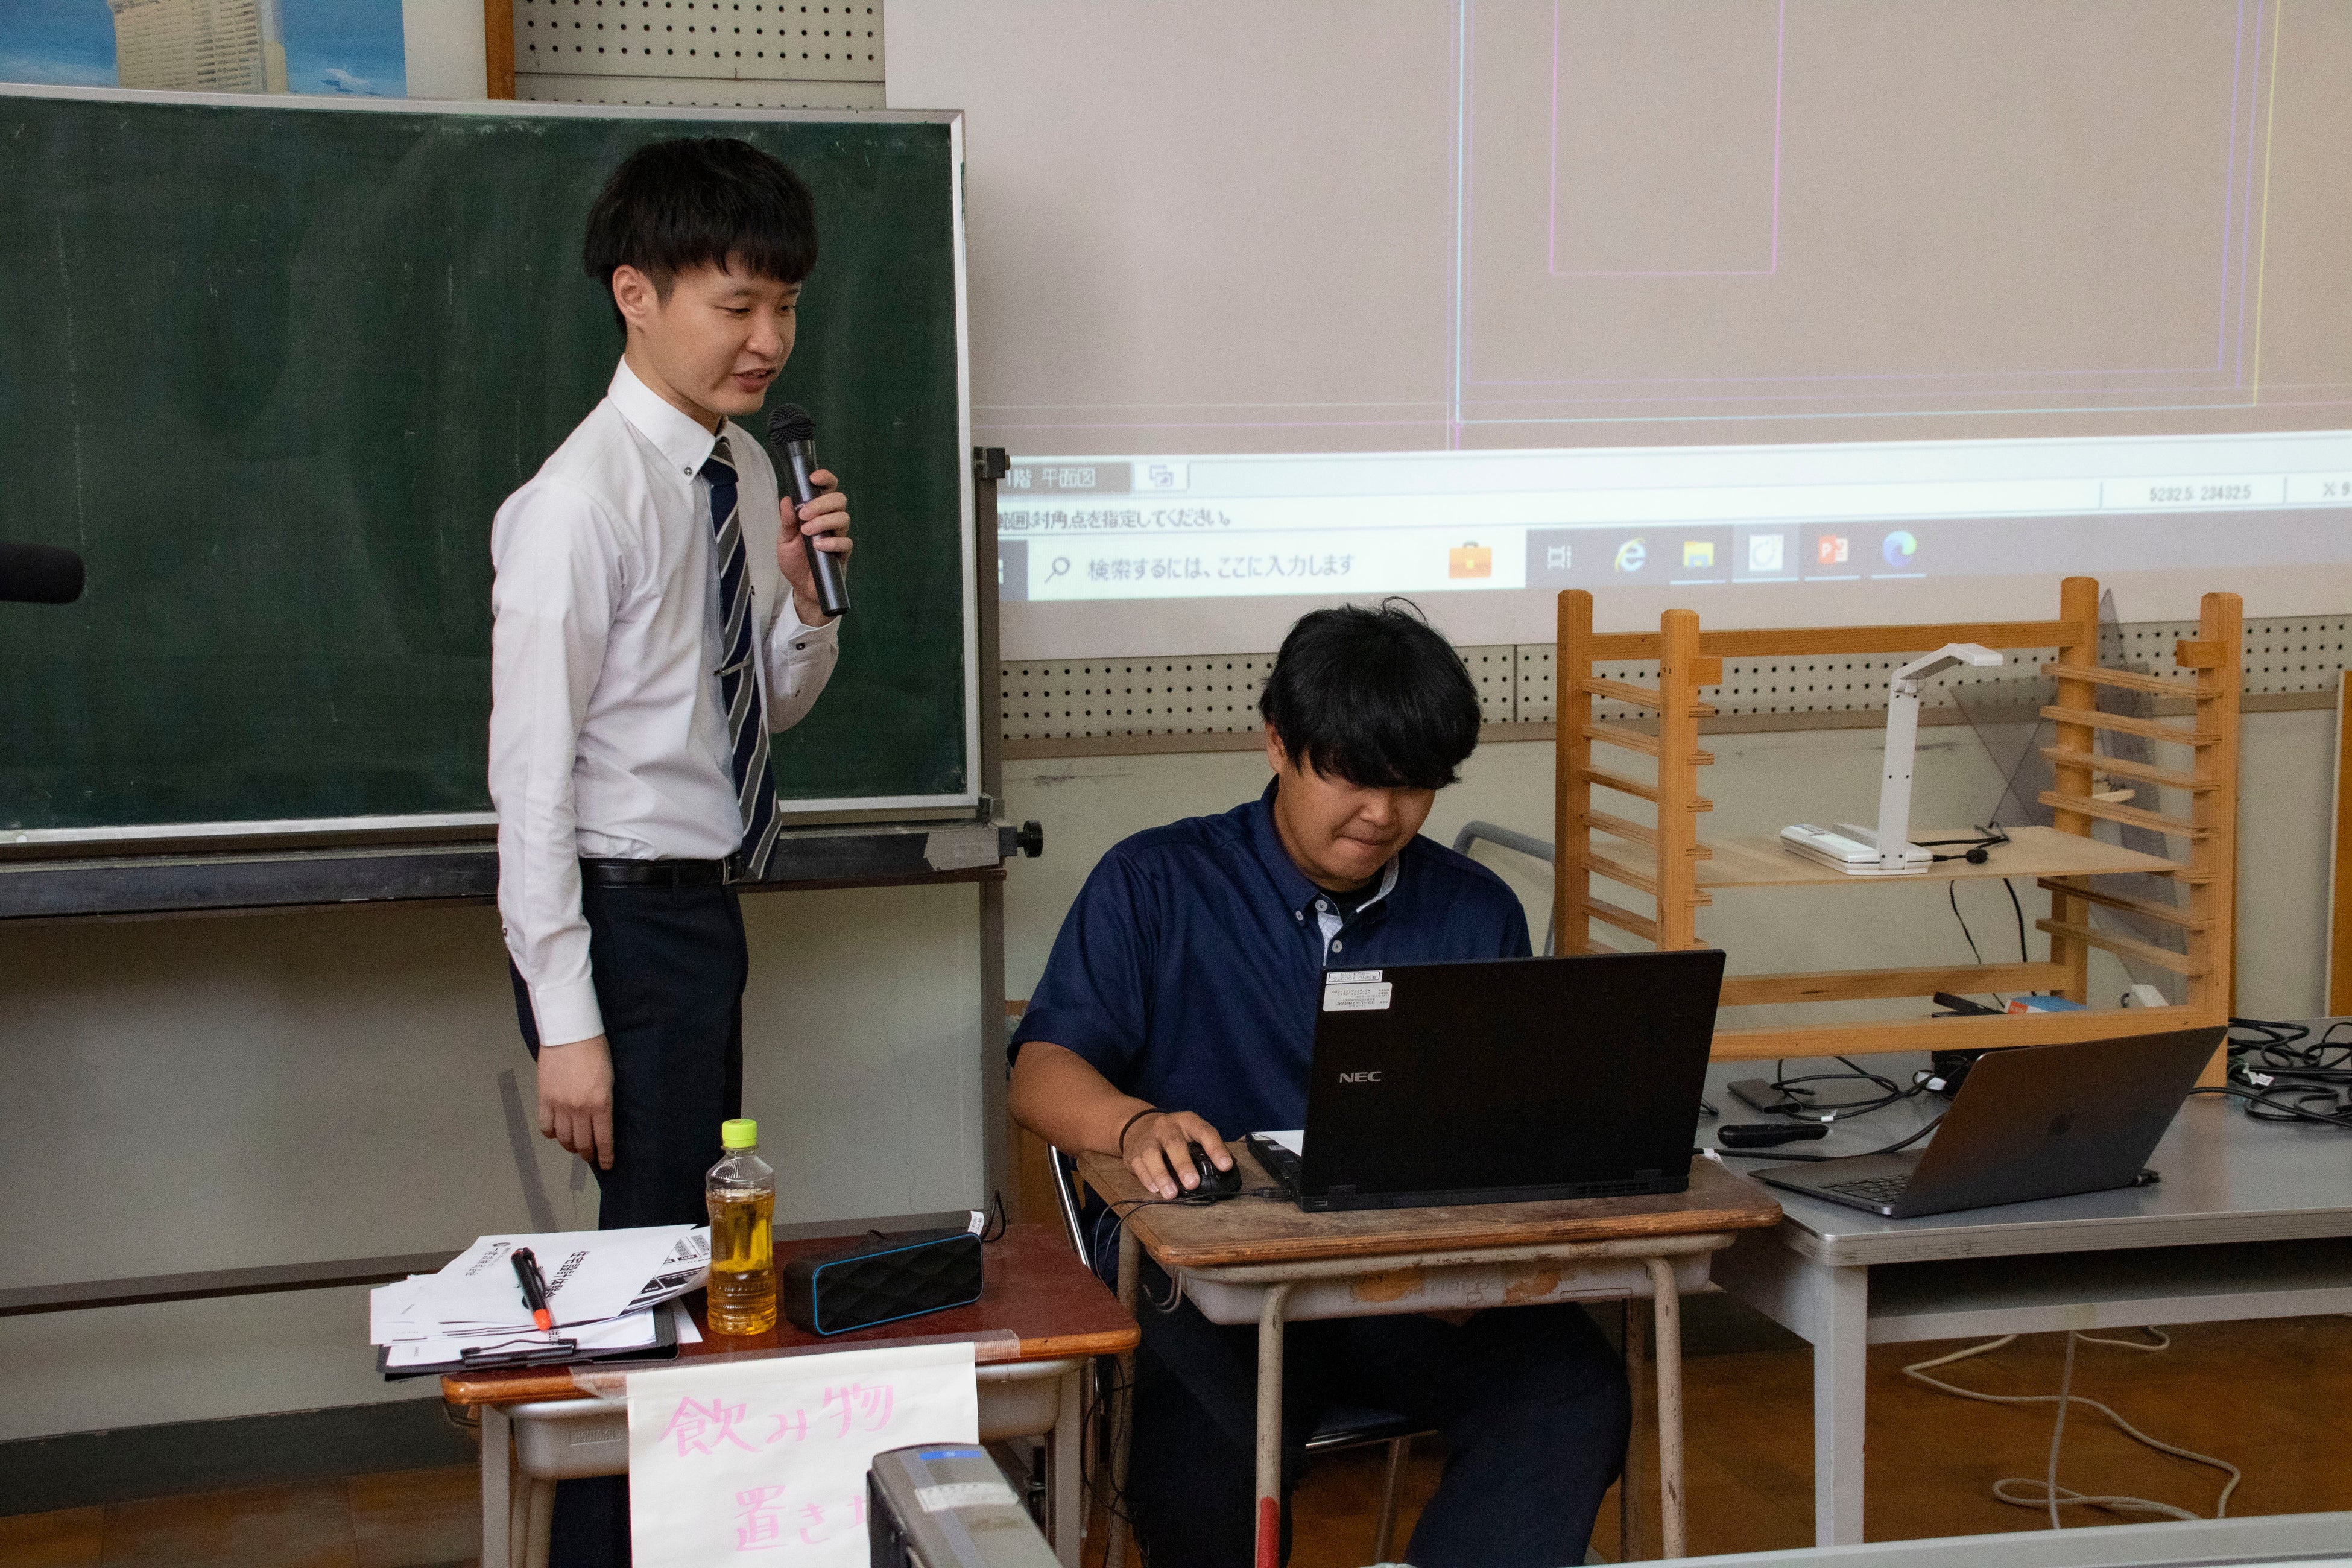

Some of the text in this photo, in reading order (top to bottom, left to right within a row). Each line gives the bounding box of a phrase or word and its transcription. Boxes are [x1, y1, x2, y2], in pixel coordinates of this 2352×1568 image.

[1042, 467, 1096, 488] 平面図
[1089, 554, 1354, 581] 検索するには、ここに入力します
[1339, 1071, 1382, 1083] NEC
[658, 1383, 894, 1457] 飲み物
